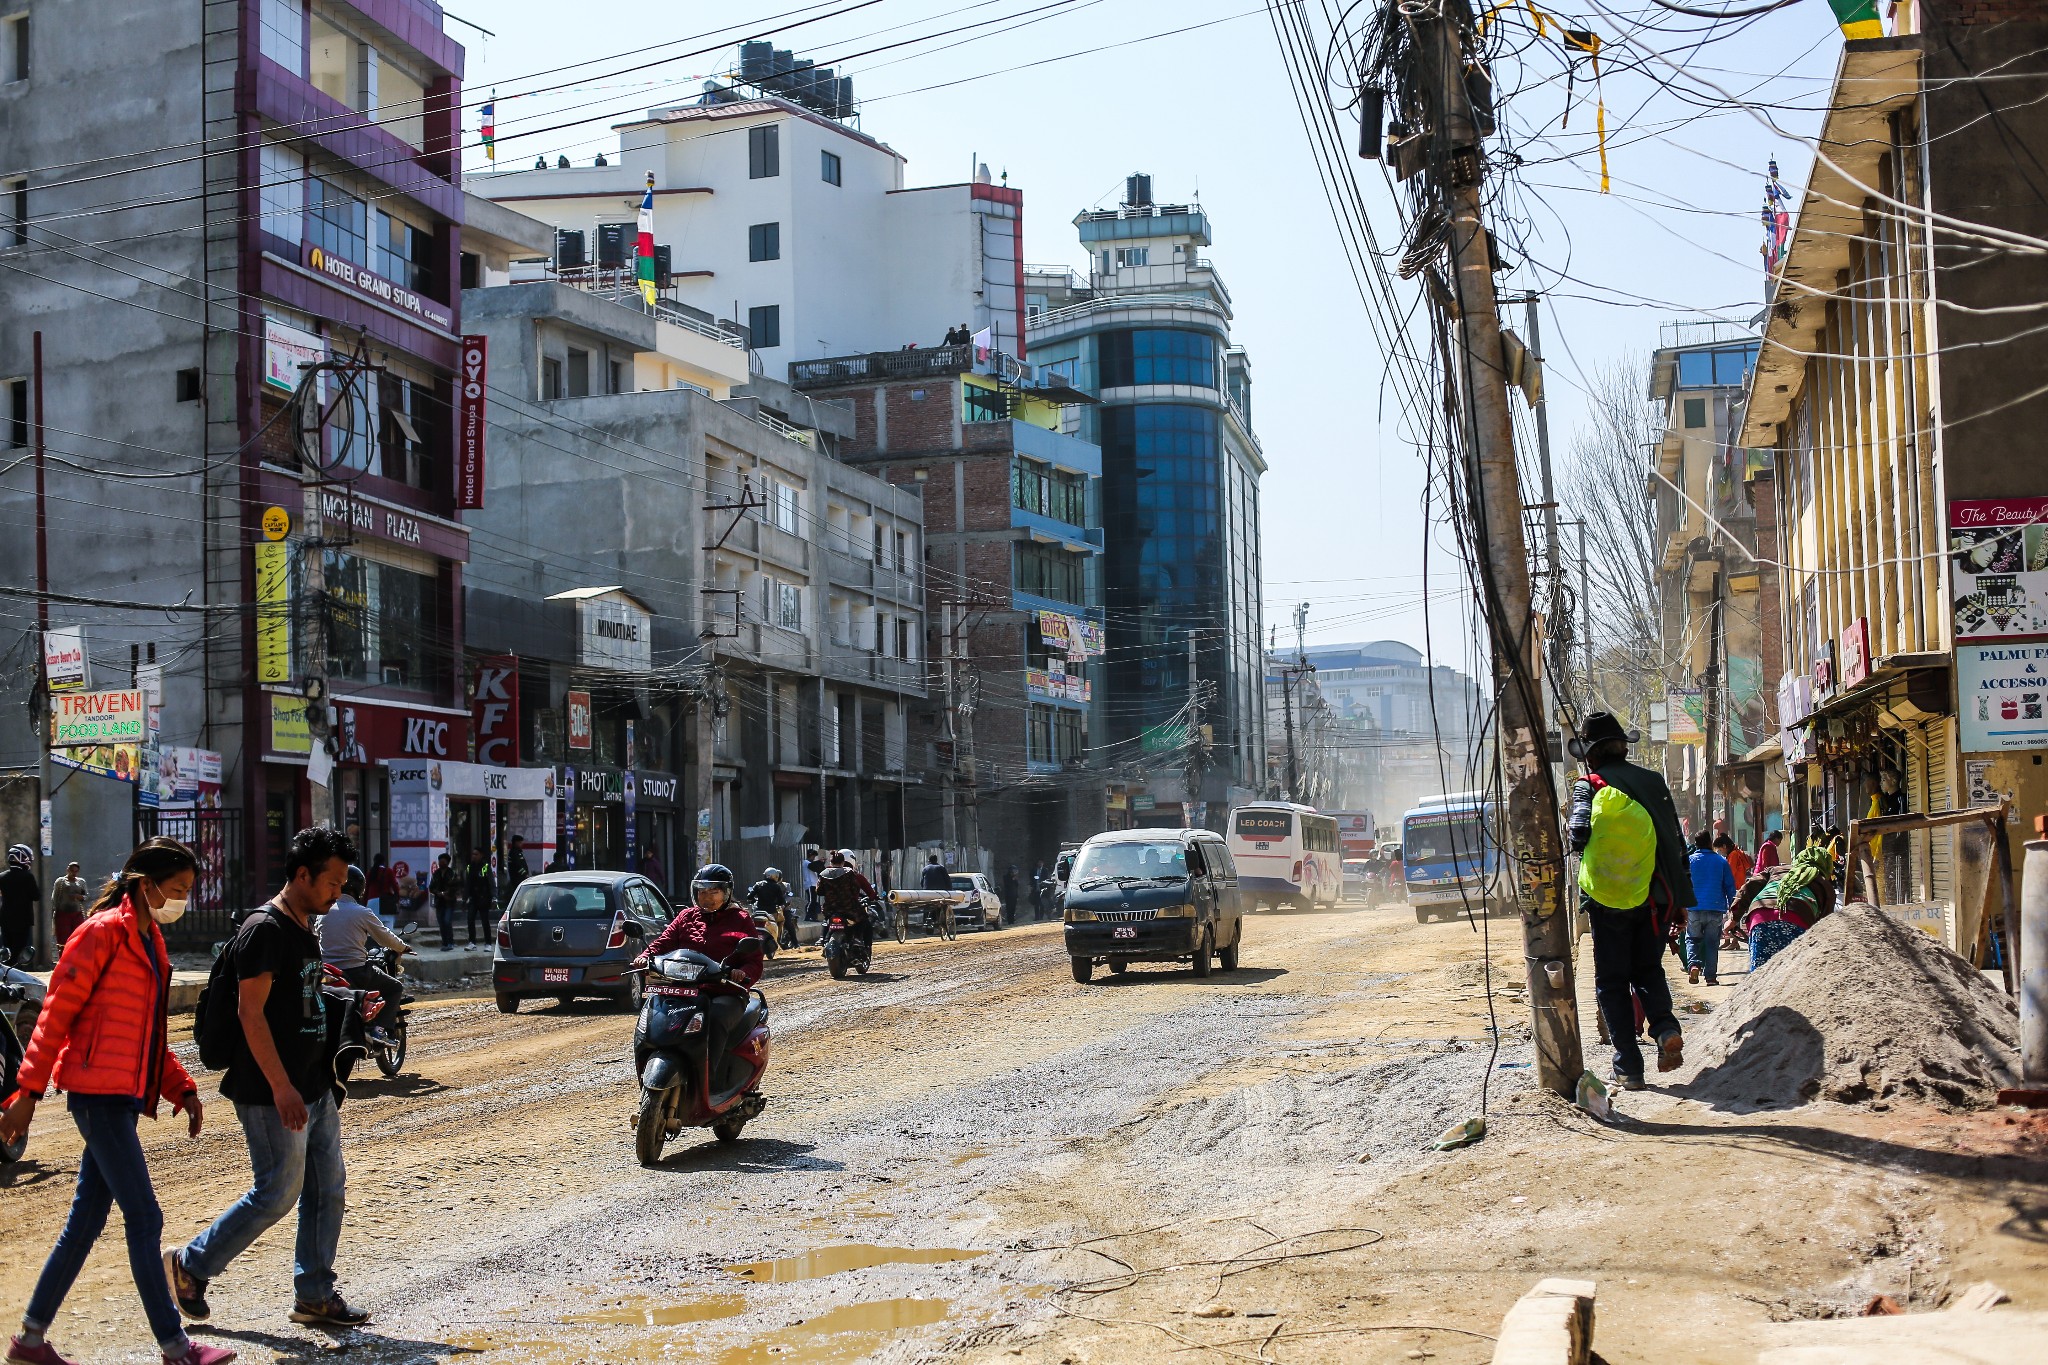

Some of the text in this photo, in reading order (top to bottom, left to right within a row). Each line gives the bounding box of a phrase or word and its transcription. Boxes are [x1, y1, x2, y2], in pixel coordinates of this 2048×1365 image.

[325, 255, 356, 285] HOTEL
[359, 271, 391, 300] GRAND
[393, 287, 421, 314] STUPA
[465, 349, 482, 398] OYO
[465, 404, 477, 504] Hotel Grand Stupa
[1961, 508, 1987, 524] The
[1991, 506, 2040, 523] Beauty
[386, 513, 420, 544] PLAZA
[598, 619, 637, 641] MINUTIAE
[1979, 649, 2031, 662] PALMU
[2025, 663, 2037, 673] &
[60, 692, 141, 716] TRIVENI
[274, 706, 290, 725] Shop
[291, 708, 302, 722] For
[475, 669, 511, 767] KFC
[59, 721, 140, 738] FOOD LAND
[405, 717, 447, 756] KFC
[399, 770, 426, 780] KFC
[490, 774, 507, 789] KFC
[581, 771, 622, 792] PHOTON
[603, 791, 622, 802] LIGHTING
[643, 778, 677, 802] STUDIO 7
[391, 794, 428, 814] 5-IN-1
[1240, 819, 1255, 827] LED
